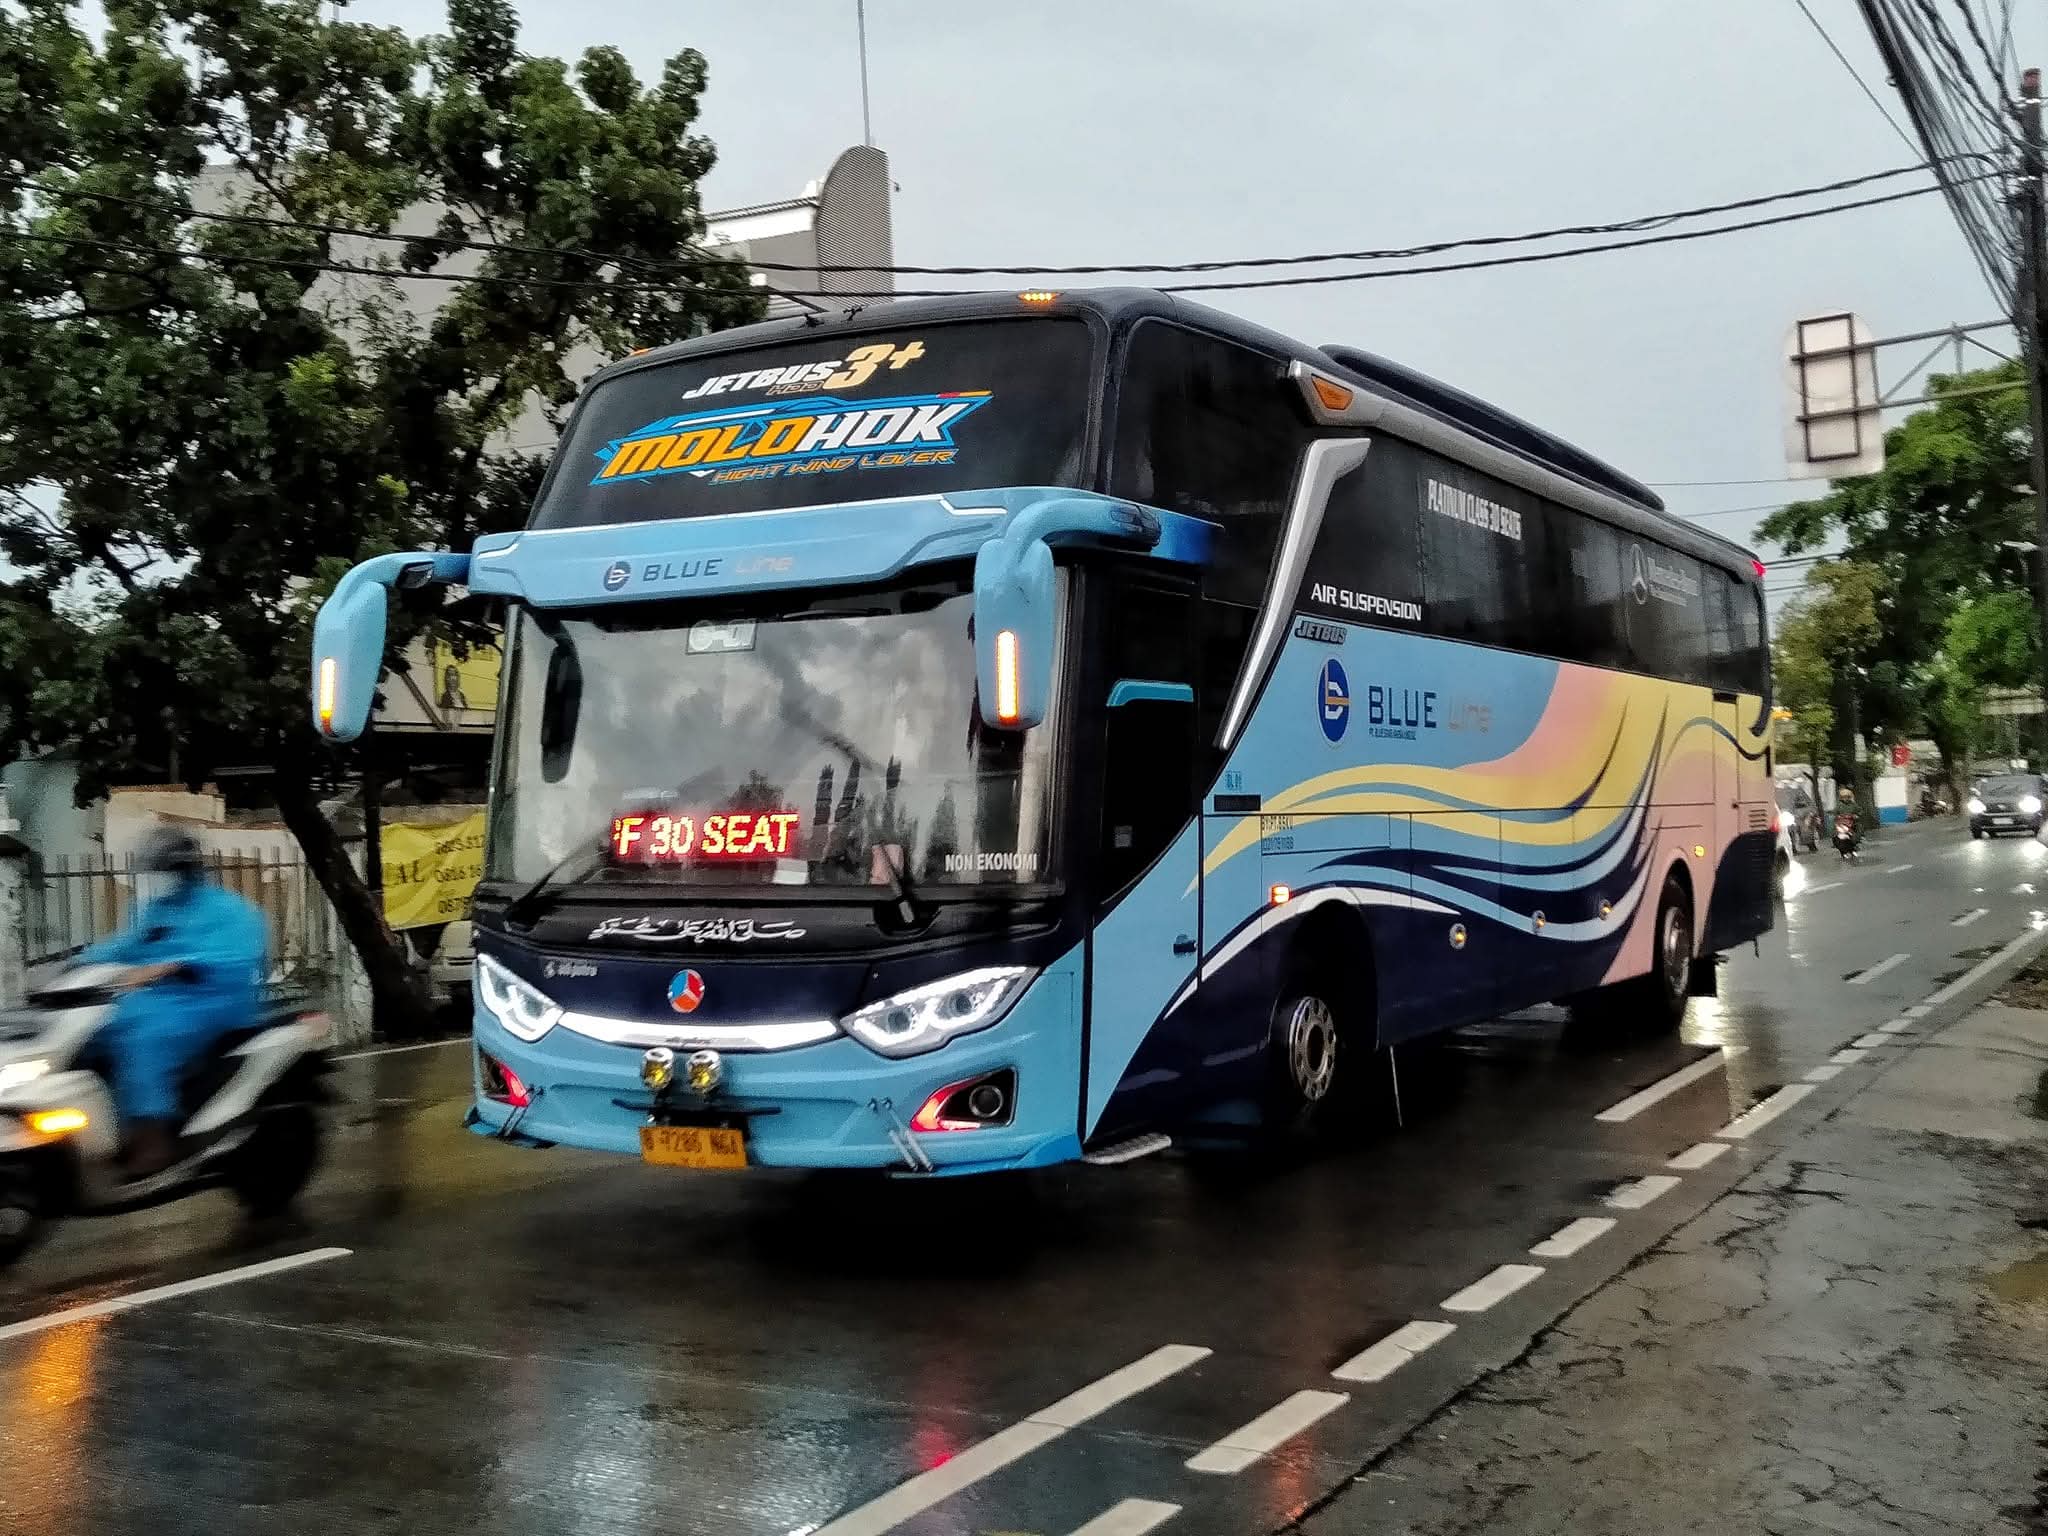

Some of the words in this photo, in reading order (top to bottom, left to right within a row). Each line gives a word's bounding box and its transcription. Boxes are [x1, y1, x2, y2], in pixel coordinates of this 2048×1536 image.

[682, 360, 842, 400] JETBUS
[600, 403, 972, 478] MOLOHOK
[788, 454, 857, 473] WIND
[861, 448, 956, 468] LOVER
[643, 558, 723, 582] BLUE
[1311, 582, 1337, 605] AIR
[1340, 589, 1421, 621] SUSPENSION
[1295, 620, 1348, 645] JETBUS
[1369, 685, 1437, 729] BLUE
[650, 815, 695, 855] 30
[701, 813, 799, 854] SEAT
[945, 853, 973, 872] NON
[977, 852, 1038, 871] EKONOMI
